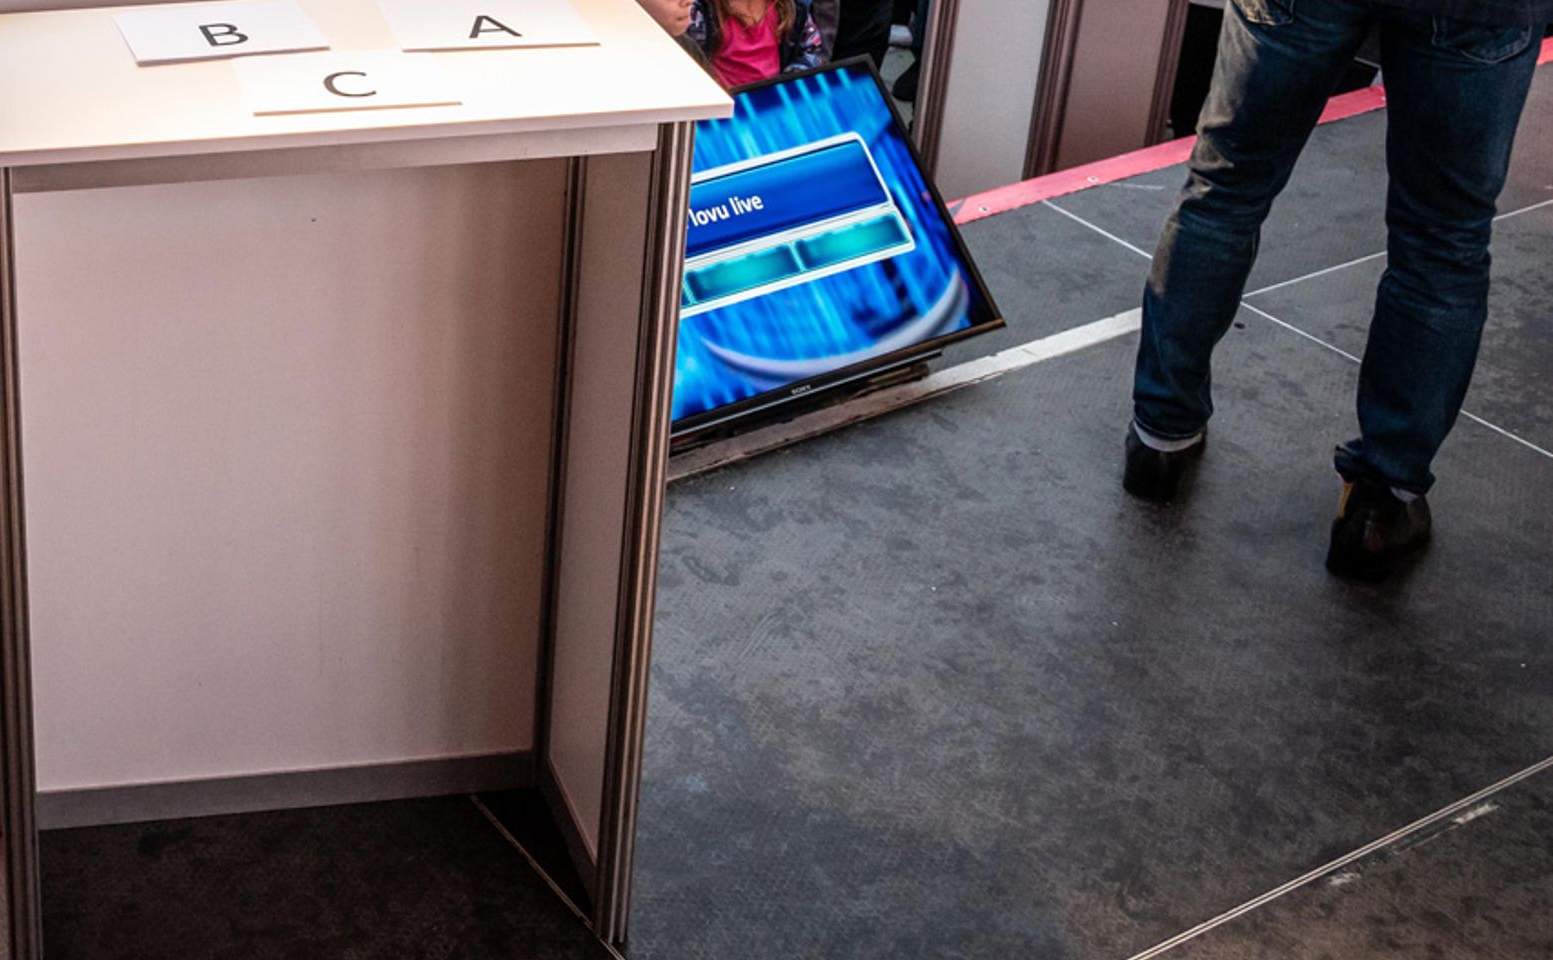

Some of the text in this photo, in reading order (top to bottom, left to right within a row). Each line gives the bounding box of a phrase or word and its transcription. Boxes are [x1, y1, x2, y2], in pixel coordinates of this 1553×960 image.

[198, 22, 249, 47] B
[469, 15, 523, 39] A
[323, 70, 377, 98] C
[728, 195, 764, 215] live
